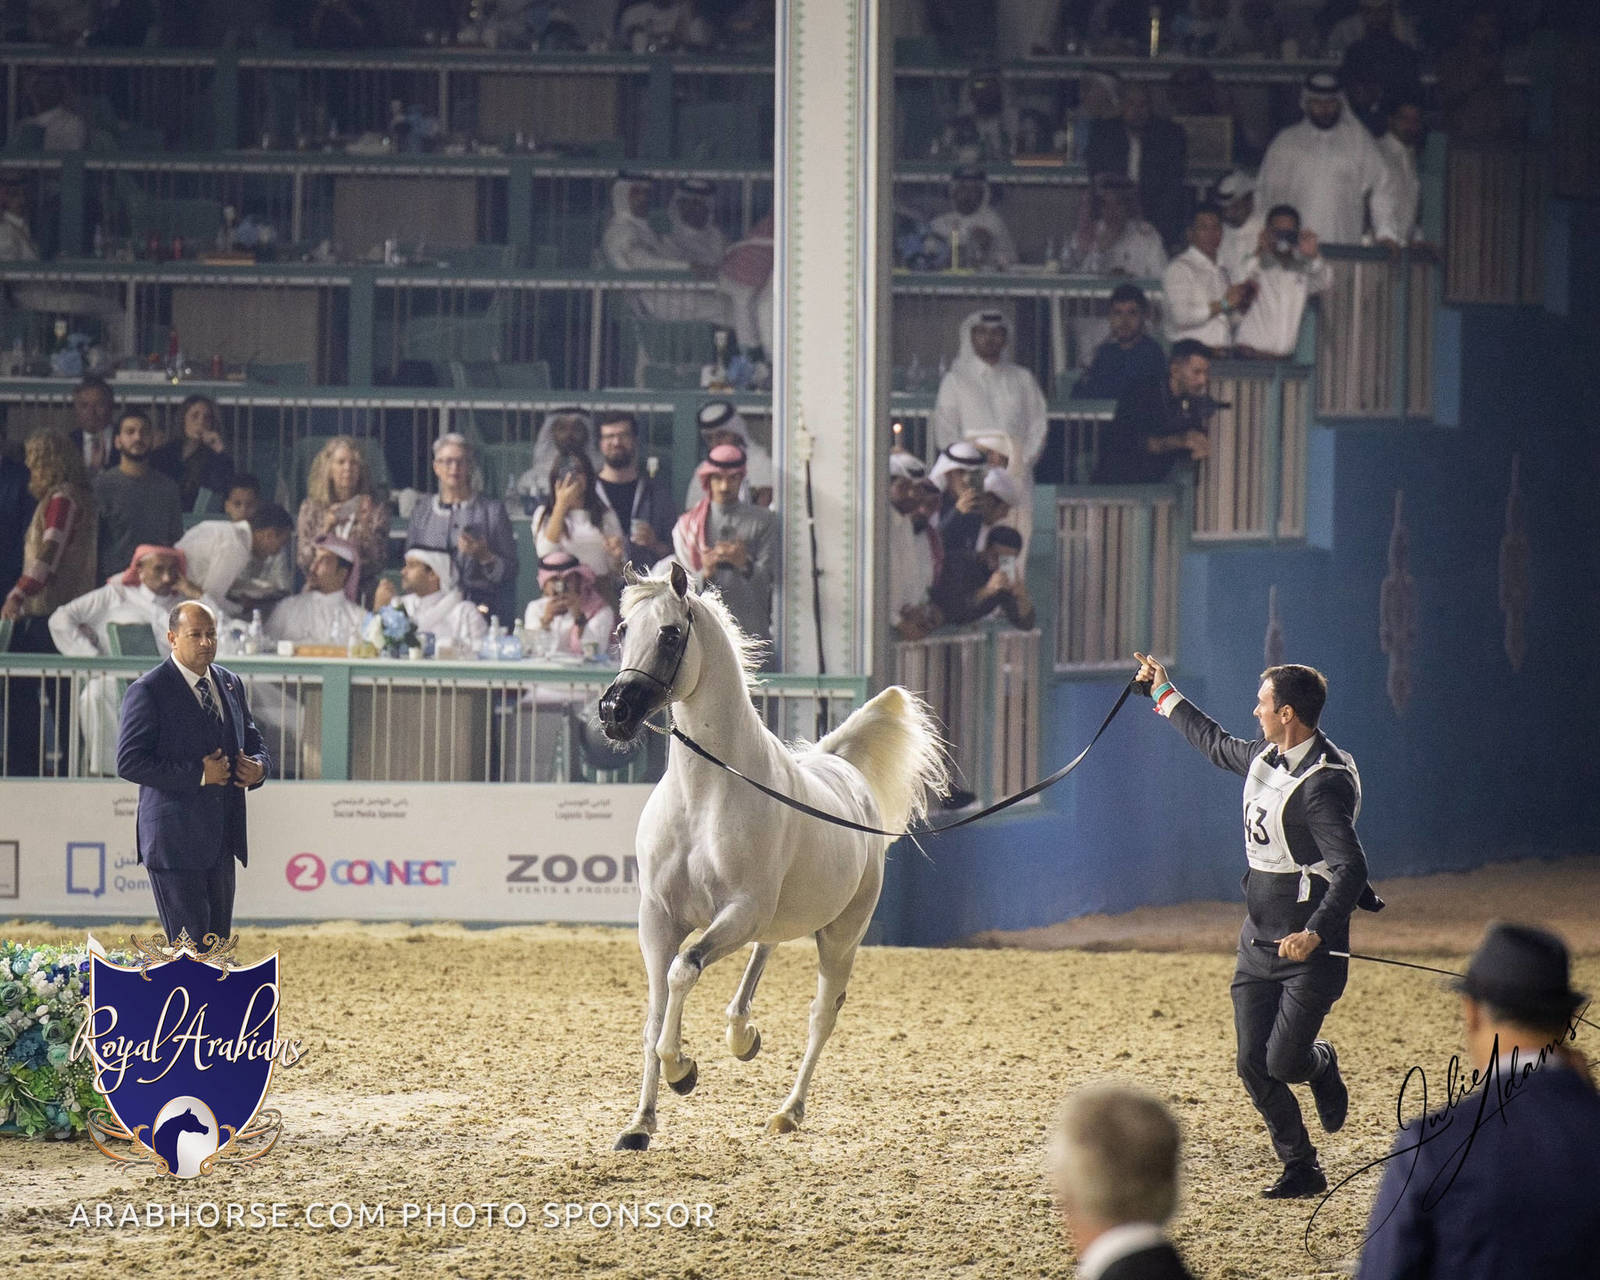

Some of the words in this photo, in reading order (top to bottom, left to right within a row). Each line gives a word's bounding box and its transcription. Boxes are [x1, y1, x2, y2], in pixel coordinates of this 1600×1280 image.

[1245, 801, 1271, 846] 43
[330, 859, 457, 887] CONNECT
[577, 886, 640, 894] PRODUCT
